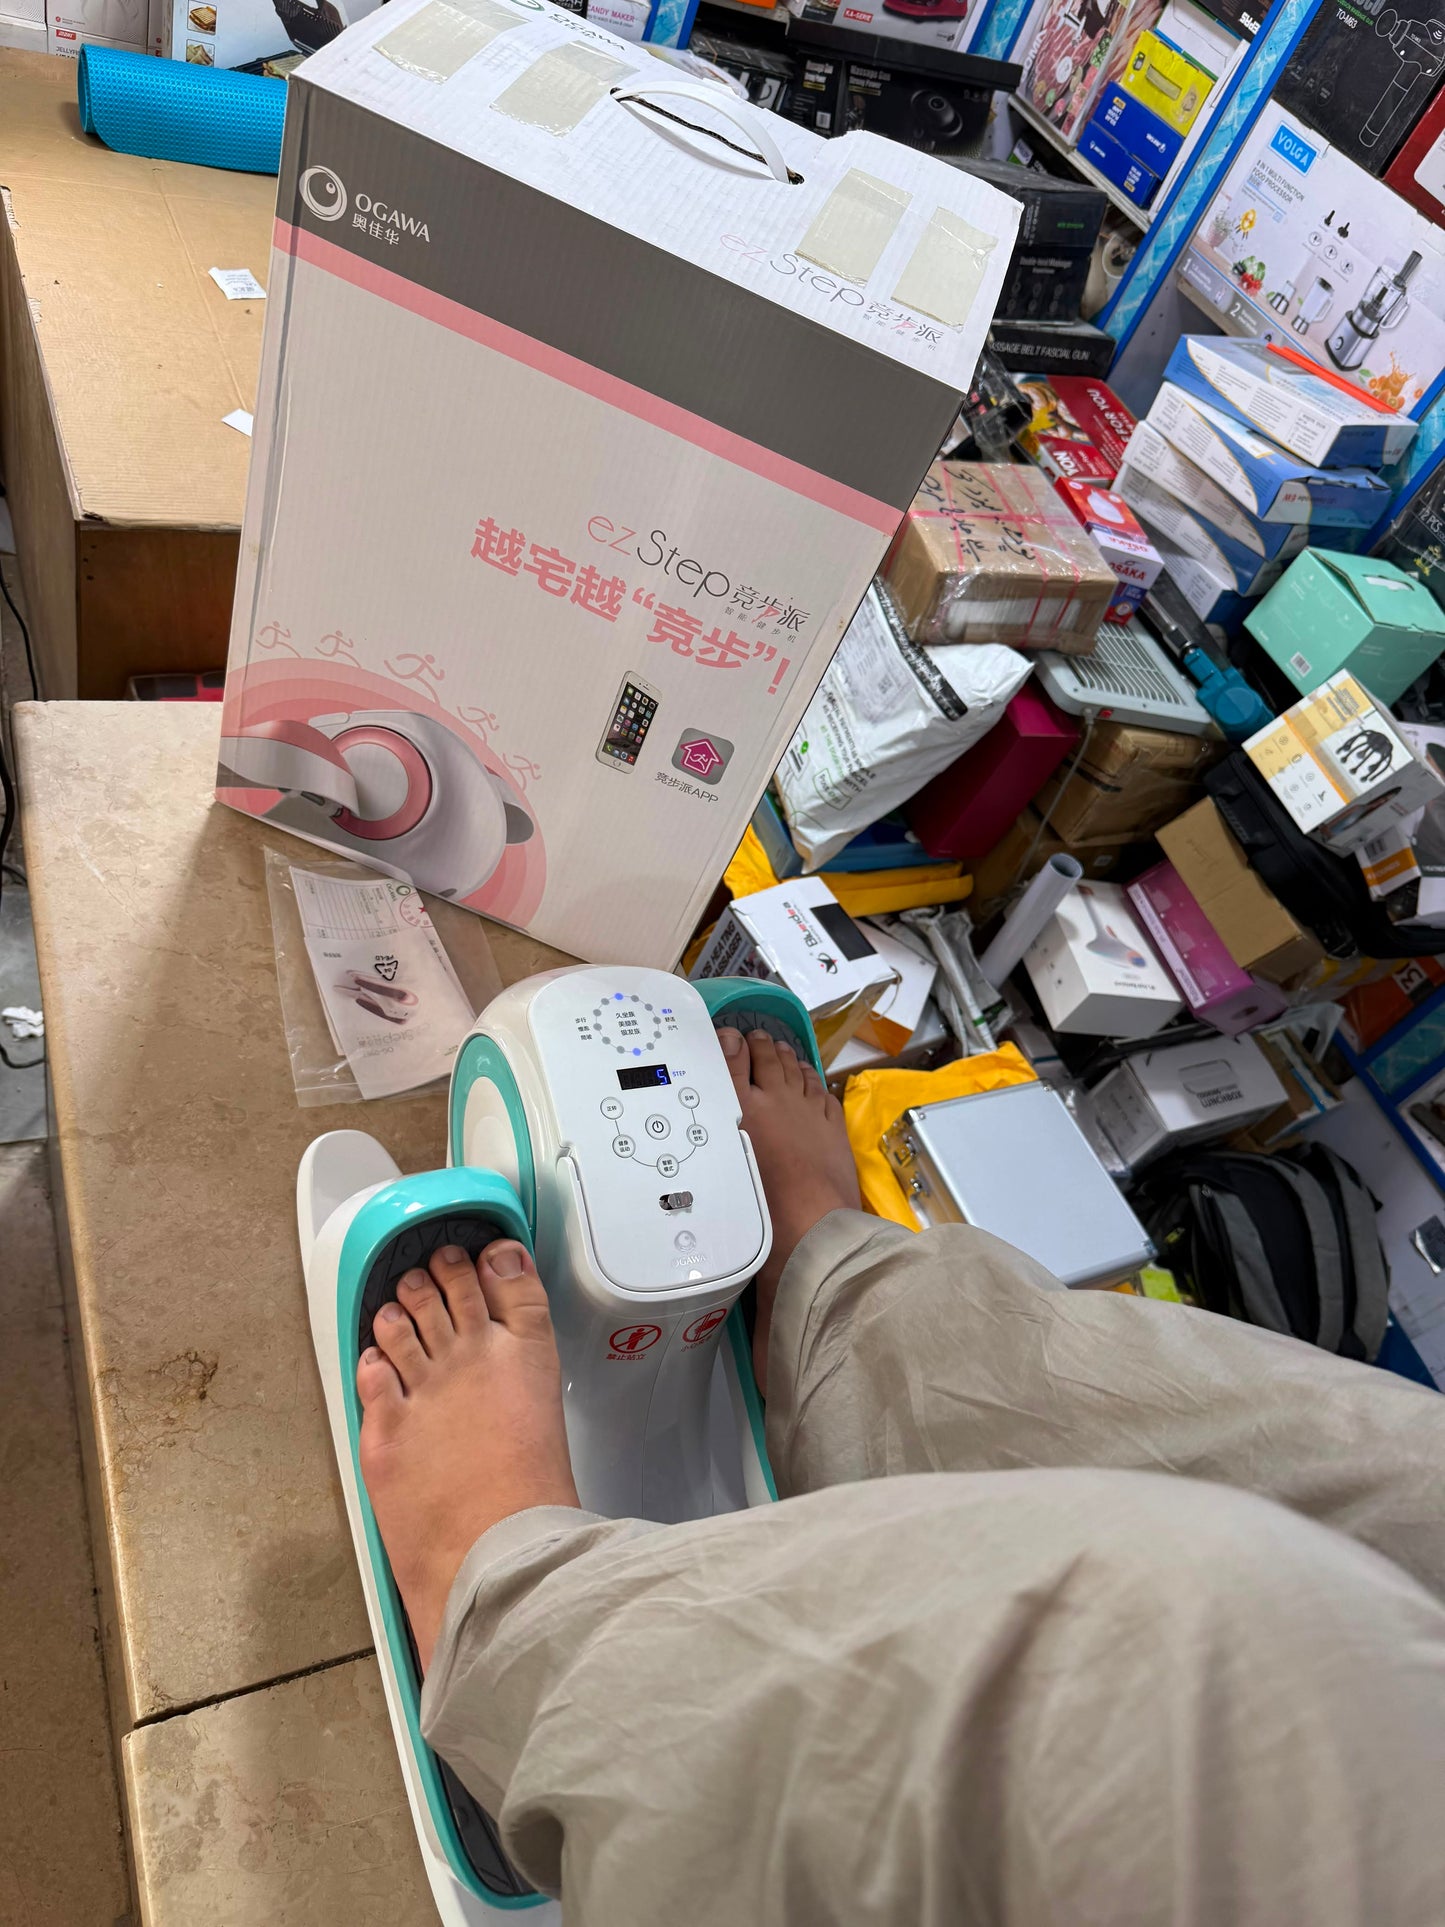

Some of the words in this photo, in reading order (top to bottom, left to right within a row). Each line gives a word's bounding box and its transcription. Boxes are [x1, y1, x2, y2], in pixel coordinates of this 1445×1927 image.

[611, 11, 635, 22] MAKER
[1336, 8, 1358, 29] TO-M63
[1277, 131, 1308, 166] VOLGA
[1252, 167, 1267, 181] FOOD
[1264, 175, 1294, 203] PROCESSOR
[1268, 167, 1283, 183] MULTI
[1280, 176, 1305, 200] FUNCTION
[351, 212, 400, 246] 奥佳华
[355, 193, 430, 243] OGAWA
[1230, 302, 1241, 317] 2
[1020, 343, 1041, 356] BELT
[1040, 344, 1071, 359] FASCIAL
[1072, 346, 1091, 361] GUN
[1426, 511, 1443, 534] PCS
[729, 583, 811, 632] 竞步派
[654, 771, 719, 803] 竞步派APP
[710, 919, 736, 961] HEATING
[616, 1011, 635, 1019] 久坐族
[656, 1068, 668, 1085] 5
[1200, 1090, 1244, 1108] LUNCHBOX
